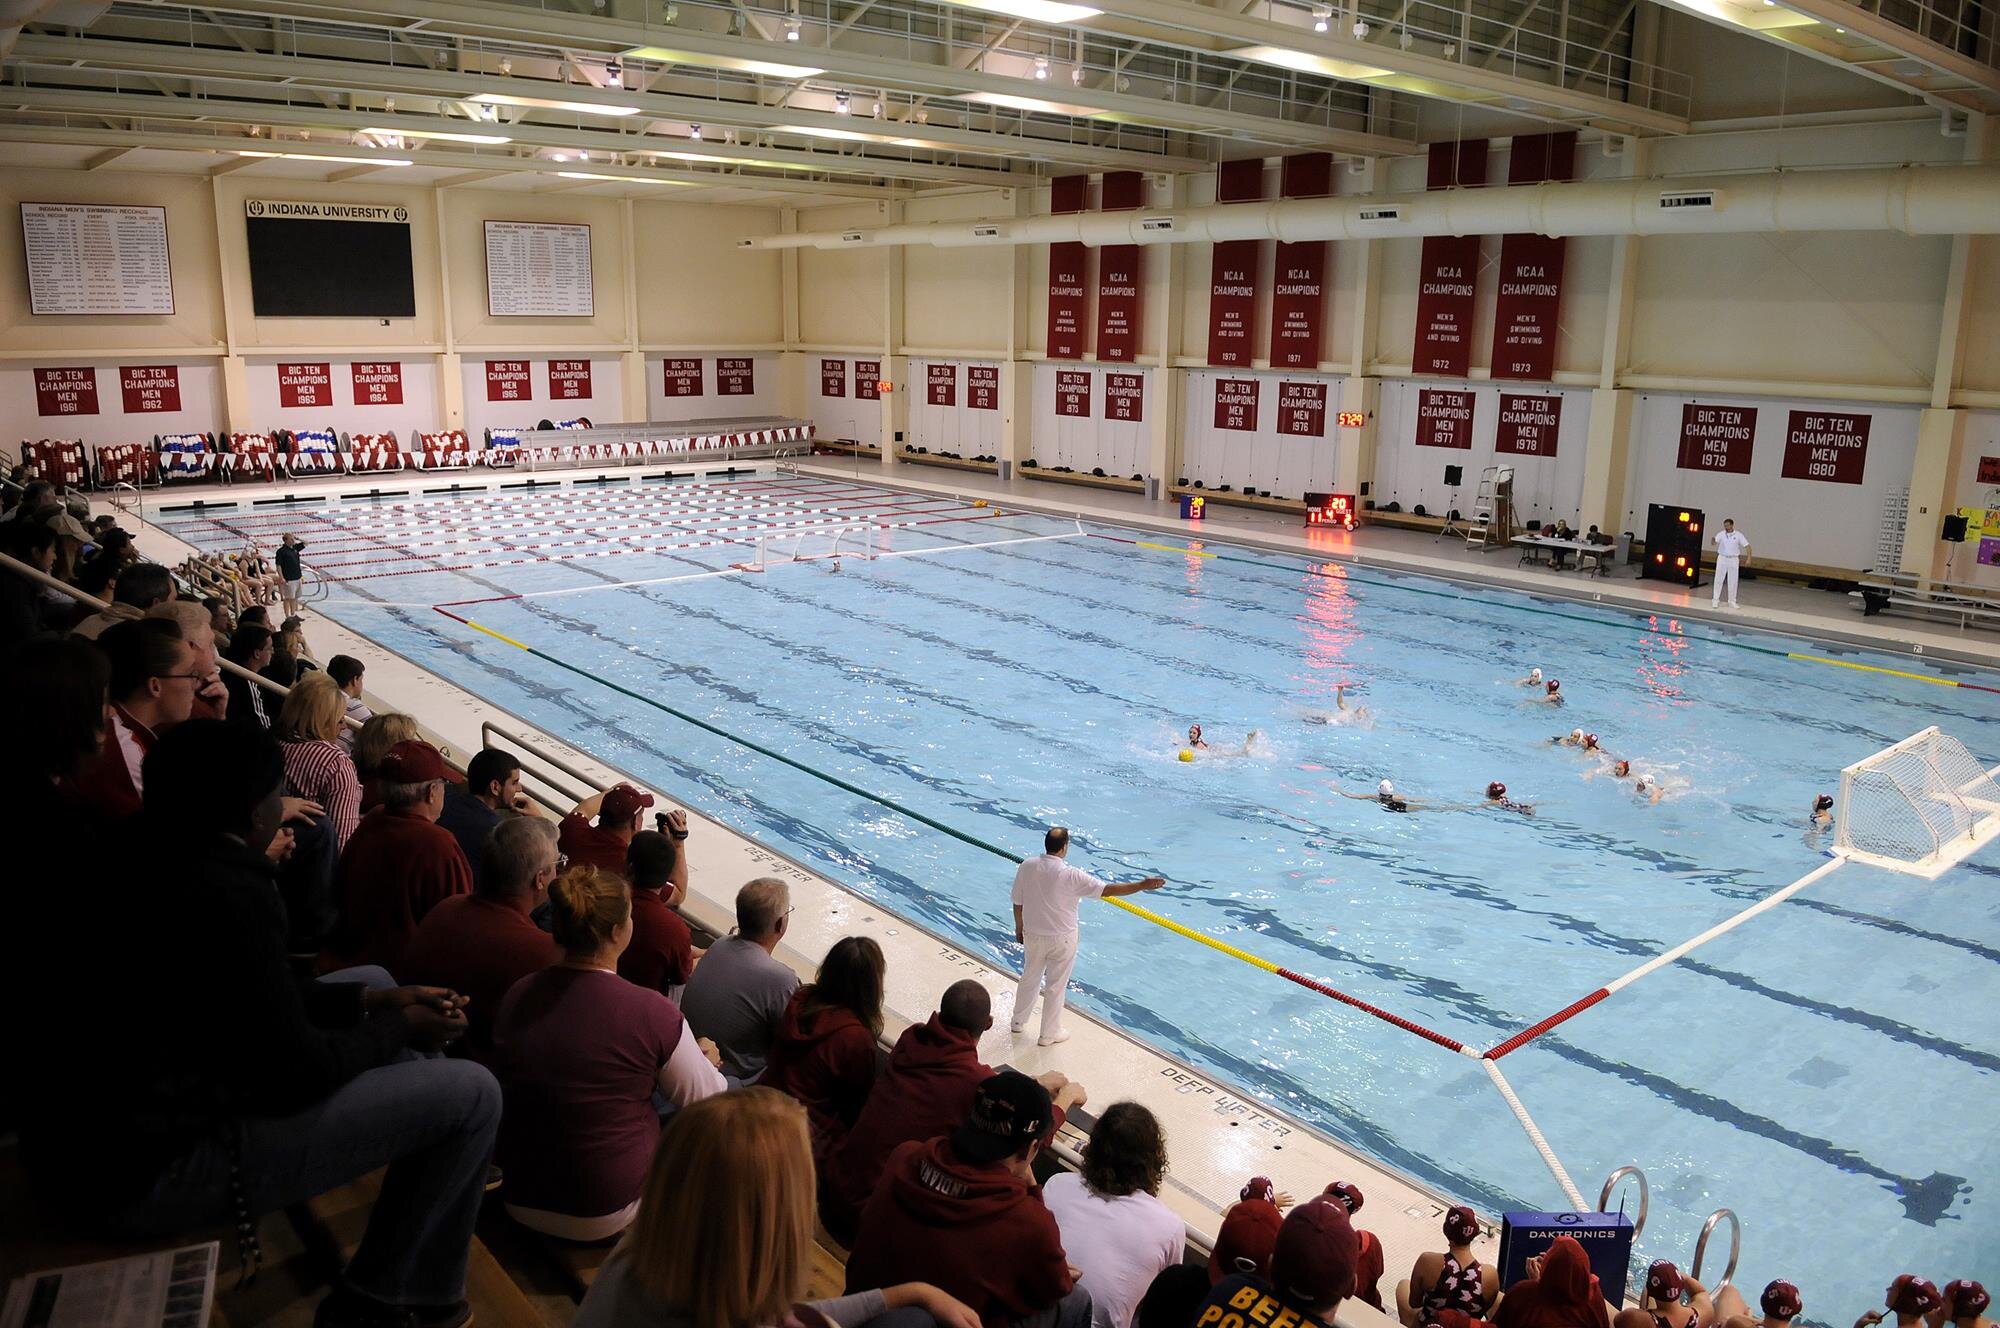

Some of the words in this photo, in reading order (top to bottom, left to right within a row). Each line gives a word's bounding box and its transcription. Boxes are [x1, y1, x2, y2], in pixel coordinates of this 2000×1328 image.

[268, 203, 319, 216] INDIANA
[322, 206, 390, 218] UNIVERSITY
[1224, 271, 1244, 281] NCAA
[1288, 269, 1310, 279] NCAA
[1436, 266, 1462, 278] NCAA
[1516, 266, 1544, 277] NCAA
[1058, 274, 1076, 283] NCAA
[1109, 273, 1128, 282] NCAA
[1051, 286, 1083, 297] CHAMPIONS
[1101, 286, 1136, 297] CHAMPIONS
[1213, 285, 1253, 297] CHAMPIONS
[1277, 285, 1320, 295] CHAMPIONS
[1423, 283, 1473, 296] CHAMPIONS
[1501, 283, 1557, 296] CHAMPIONS
[1430, 323, 1458, 331] SWIMMING
[1509, 325, 1540, 334] SWIMMING
[1505, 336, 1519, 344] AND
[1520, 336, 1542, 345] DIVING
[1222, 353, 1236, 361] 1970
[1287, 354, 1301, 362] 1971
[494, 363, 506, 371] BIG
[507, 363, 522, 371] TEN
[556, 362, 567, 370] BIG
[569, 362, 583, 370] TEN
[671, 361, 681, 369] BIG
[735, 360, 746, 368] TEN
[1432, 359, 1450, 369] 1972
[1512, 363, 1531, 373] 1973
[131, 370, 146, 379] BIG
[149, 369, 167, 378] TEN
[288, 366, 301, 375] BIG
[304, 366, 320, 374] TEN
[361, 365, 374, 374] BIG
[376, 365, 391, 373] TEN
[666, 369, 700, 377] CHAMPIONS
[974, 370, 982, 378] BIG
[983, 370, 992, 379] TEN
[46, 371, 61, 380] BIG
[65, 371, 83, 379] TEN
[281, 375, 328, 384] CHAMPIONS
[355, 374, 398, 383] CHAMPIONS
[488, 372, 528, 380] CHAMPIONS
[551, 371, 589, 379] CHAMPIONS
[729, 376, 742, 384] MEN
[1063, 374, 1072, 383] BIG
[1073, 374, 1084, 384] TEN
[39, 381, 93, 391] CHAMPIONS
[124, 378, 176, 389] CHAMPIONS
[501, 381, 517, 389] MEN
[563, 380, 578, 388] MEN
[969, 378, 996, 388] CHAMPIONS
[1113, 377, 1123, 386] BIG
[1125, 377, 1136, 387] TEN
[297, 386, 314, 394] MEN
[369, 384, 386, 392] MEN
[977, 388, 988, 397] MEN
[1057, 384, 1088, 394] CHAMPIONS
[1107, 387, 1141, 397] CHAMPIONS
[1224, 383, 1235, 393] BIG
[1238, 384, 1250, 394] TEN
[1288, 386, 1300, 397] BIG
[1302, 388, 1317, 398] TEN
[57, 392, 78, 401] MEN
[141, 389, 160, 399] MEN
[369, 394, 387, 402] 1964
[502, 390, 518, 398] 1965
[1066, 394, 1079, 403] MEN
[1217, 393, 1256, 405] CHAMPIONS
[142, 400, 162, 409] 1962
[298, 395, 315, 404] 1963
[1117, 398, 1130, 407] MEN
[1281, 397, 1323, 410] CHAMPIONS
[1429, 394, 1444, 406] BIG
[1446, 395, 1463, 406] TEN
[59, 403, 77, 412] 1961
[1066, 404, 1079, 413] 1973
[1229, 406, 1244, 415] MEN
[1512, 399, 1527, 411] BIG
[1530, 400, 1549, 412] TEN
[1116, 408, 1130, 417] 1974
[1293, 410, 1309, 420] MEN
[1421, 406, 1470, 420] CHAMPIONS
[1698, 410, 1715, 423] BIG
[1720, 411, 1741, 425] TEN
[1227, 417, 1243, 427] 1975
[1339, 414, 1363, 425] 57:29
[1502, 411, 1556, 426] CHAMPIONS
[1292, 421, 1309, 432] 1976
[1435, 420, 1454, 432] MEN
[1805, 417, 1824, 431] BIG
[1829, 418, 1854, 432] TEN
[1517, 426, 1538, 438] MEN
[1685, 424, 1750, 440] CHAMPIONS
[1434, 432, 1453, 444] 1977
[1791, 431, 1862, 448] CHAMPIONS
[1516, 439, 1537, 451] 1978
[1703, 439, 1728, 453] MEN
[1811, 447, 1838, 462] MEN
[1702, 453, 1727, 467] 1979
[1808, 462, 1836, 477] 1980
[1310, 512, 1322, 523] 11
[1326, 509, 1334, 519] 4
[938, 947, 962, 961] 7.5
[1160, 1067, 1216, 1095] DEEP
[1215, 1096, 1292, 1138] WATER
[1449, 1213, 1460, 1225] 8
[1529, 1230, 1616, 1239] DAKTRONICS
